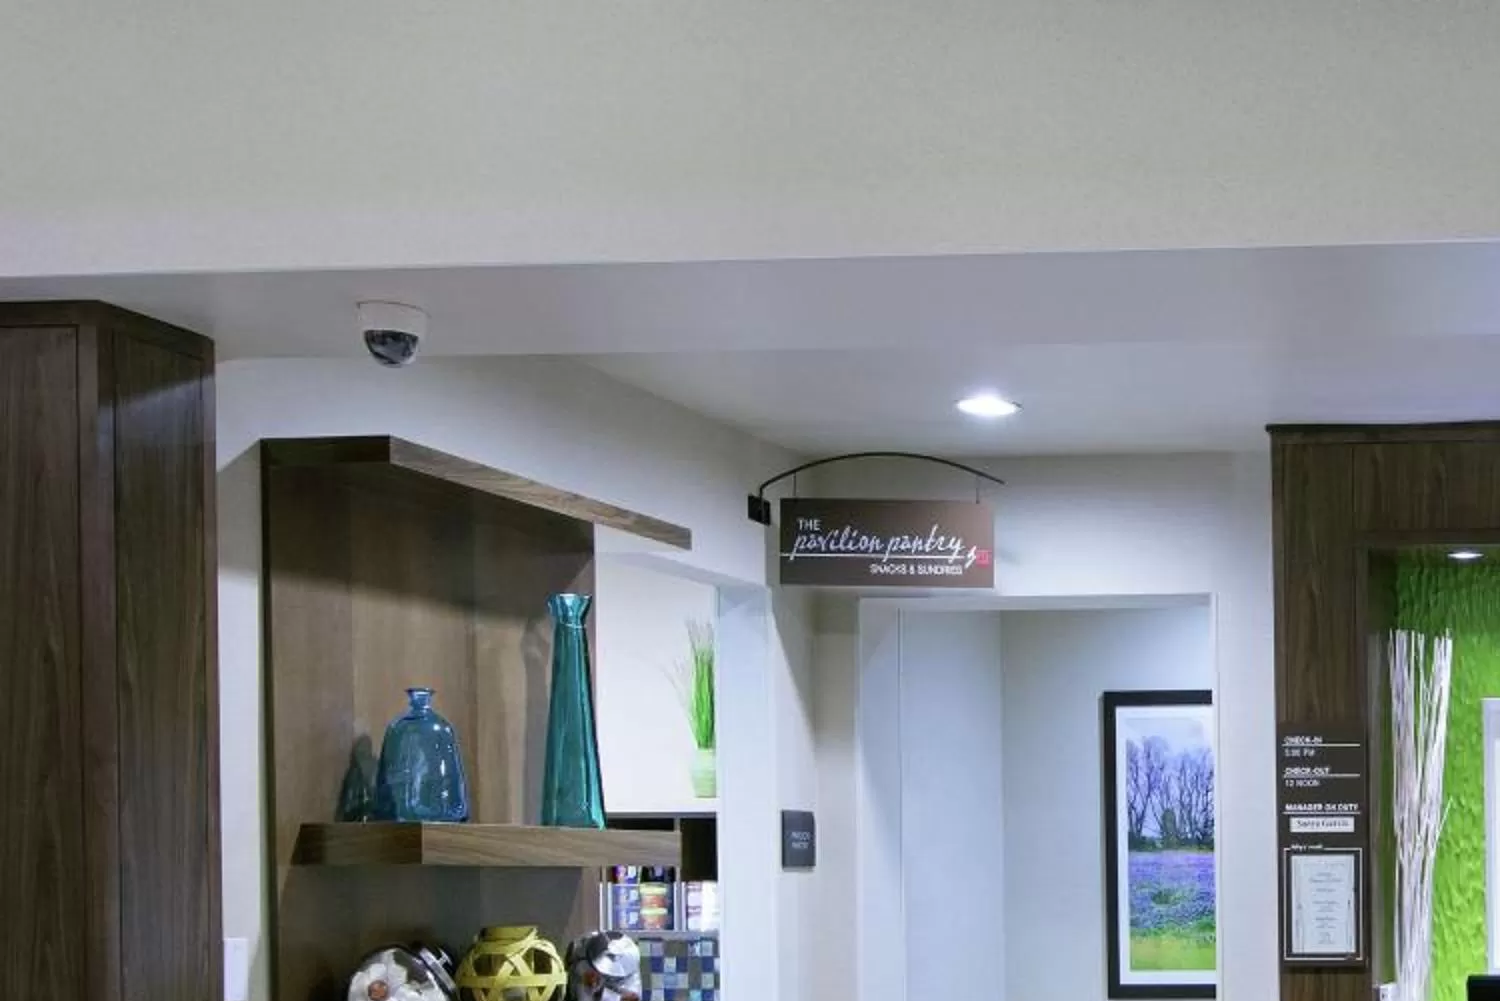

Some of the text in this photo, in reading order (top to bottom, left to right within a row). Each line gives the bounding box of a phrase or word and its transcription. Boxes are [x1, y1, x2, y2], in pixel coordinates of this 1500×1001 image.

[798, 519, 821, 532] THE
[790, 523, 966, 563] pavilion pantry
[869, 563, 907, 575] SNACKS
